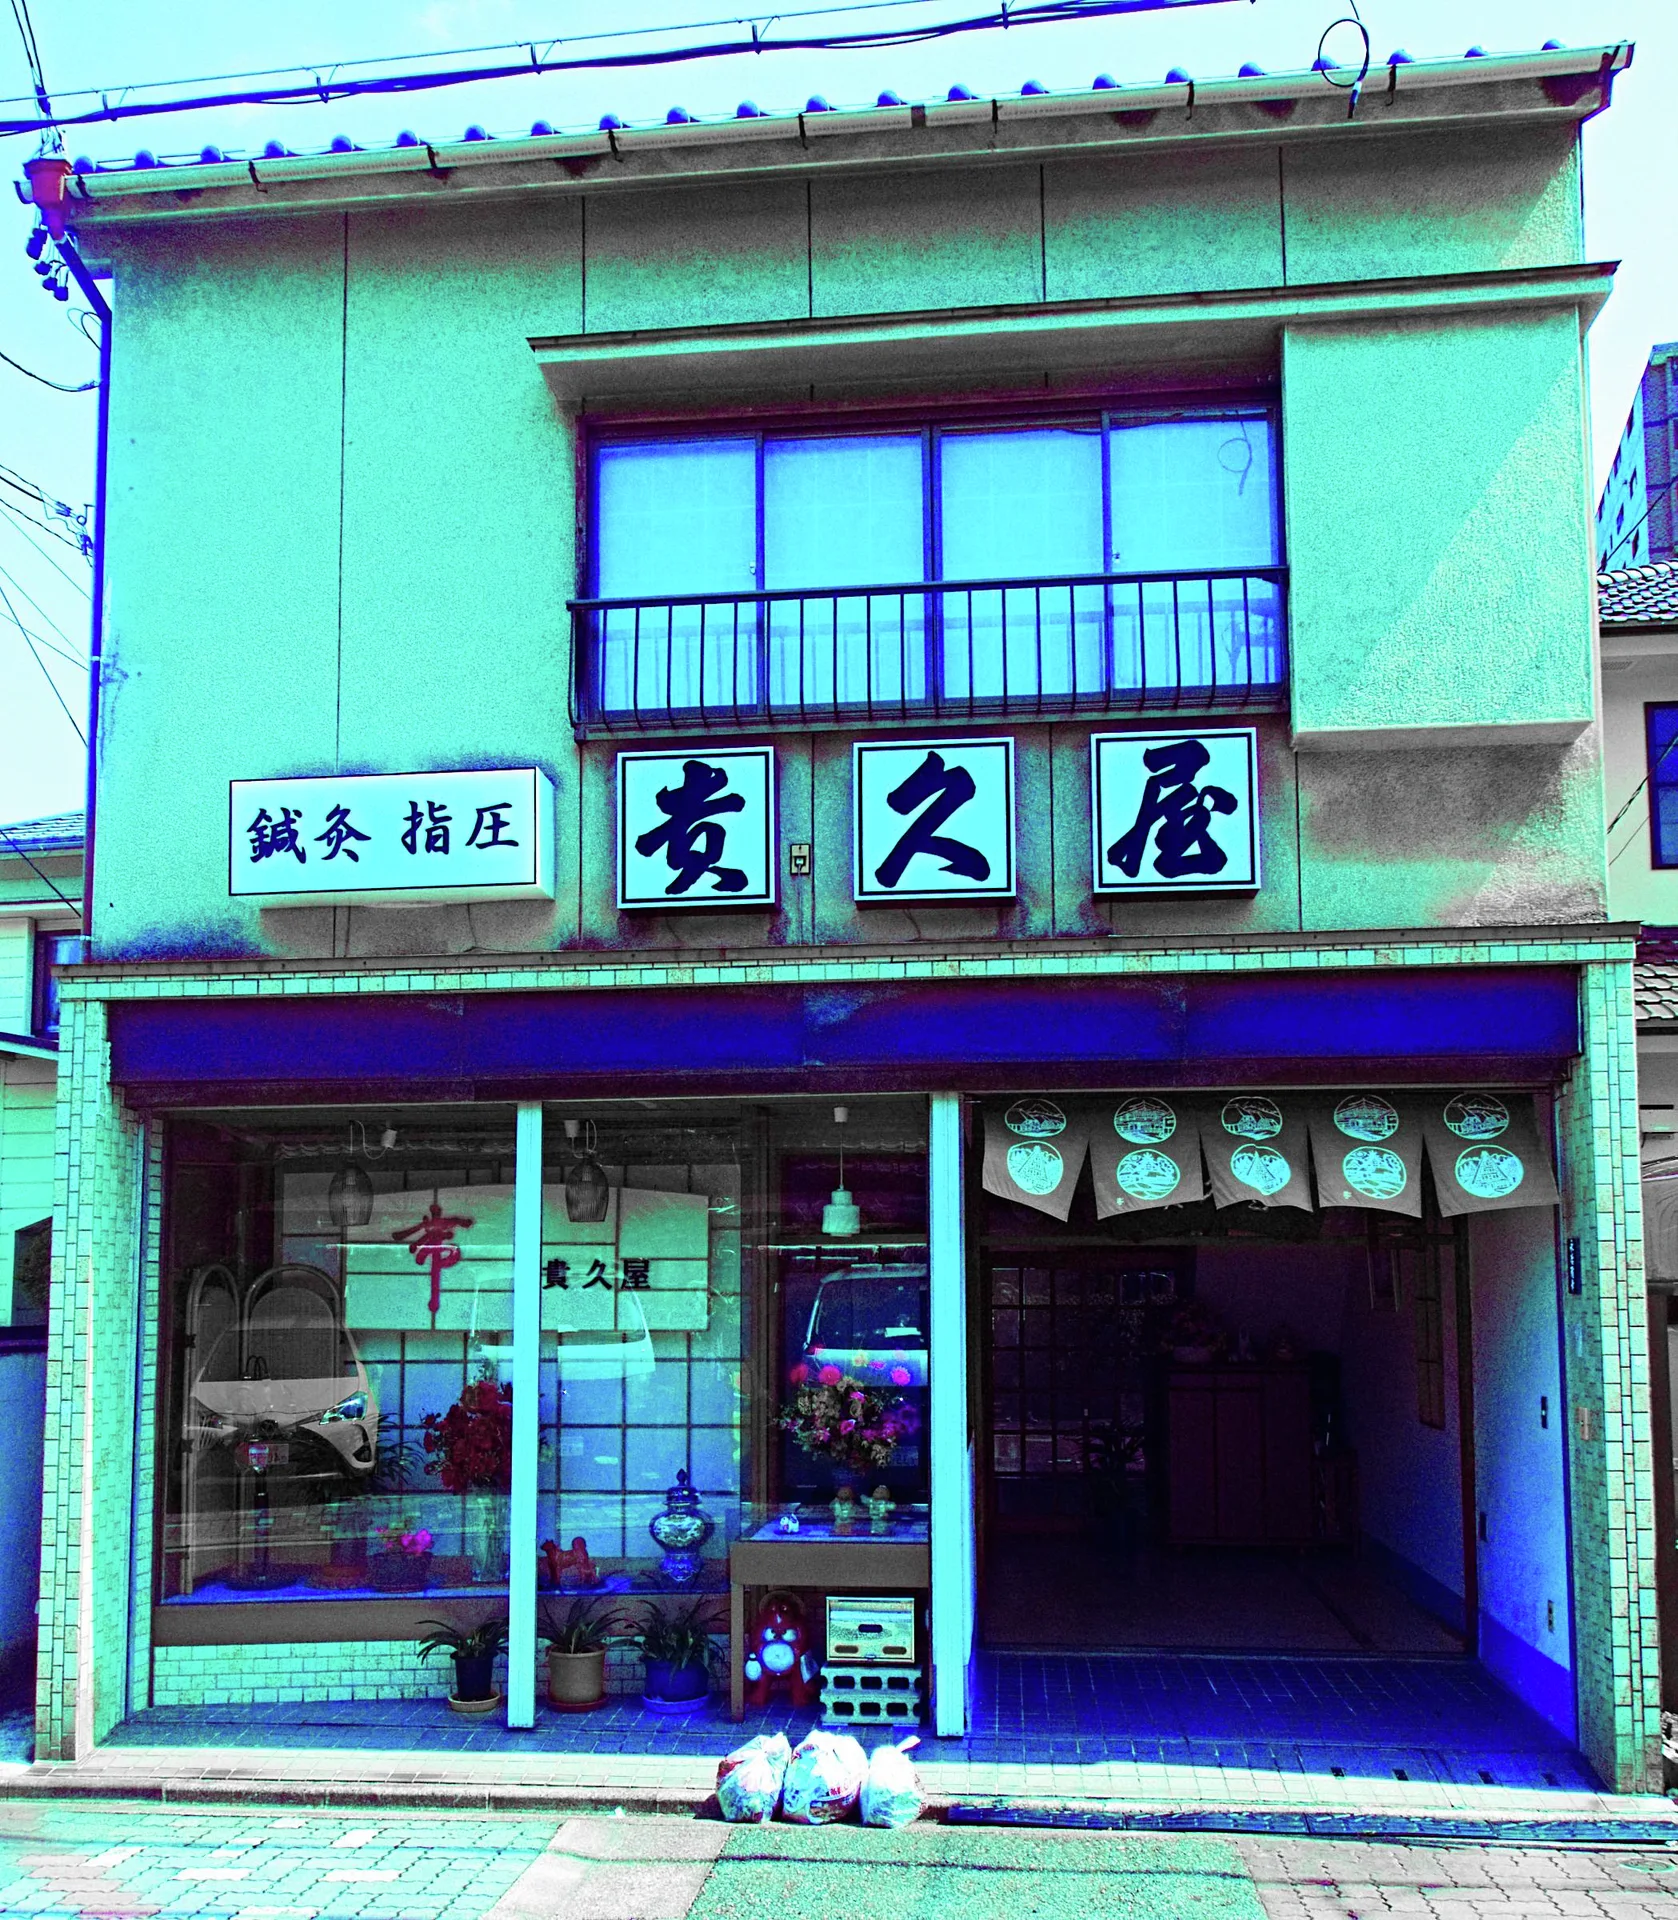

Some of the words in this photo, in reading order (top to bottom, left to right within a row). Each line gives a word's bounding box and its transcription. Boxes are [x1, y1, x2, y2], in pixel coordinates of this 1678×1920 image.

[246, 803, 372, 864] 鍼灸
[400, 800, 520, 855] 指圧
[541, 1258, 651, 1291] 貴久屋
